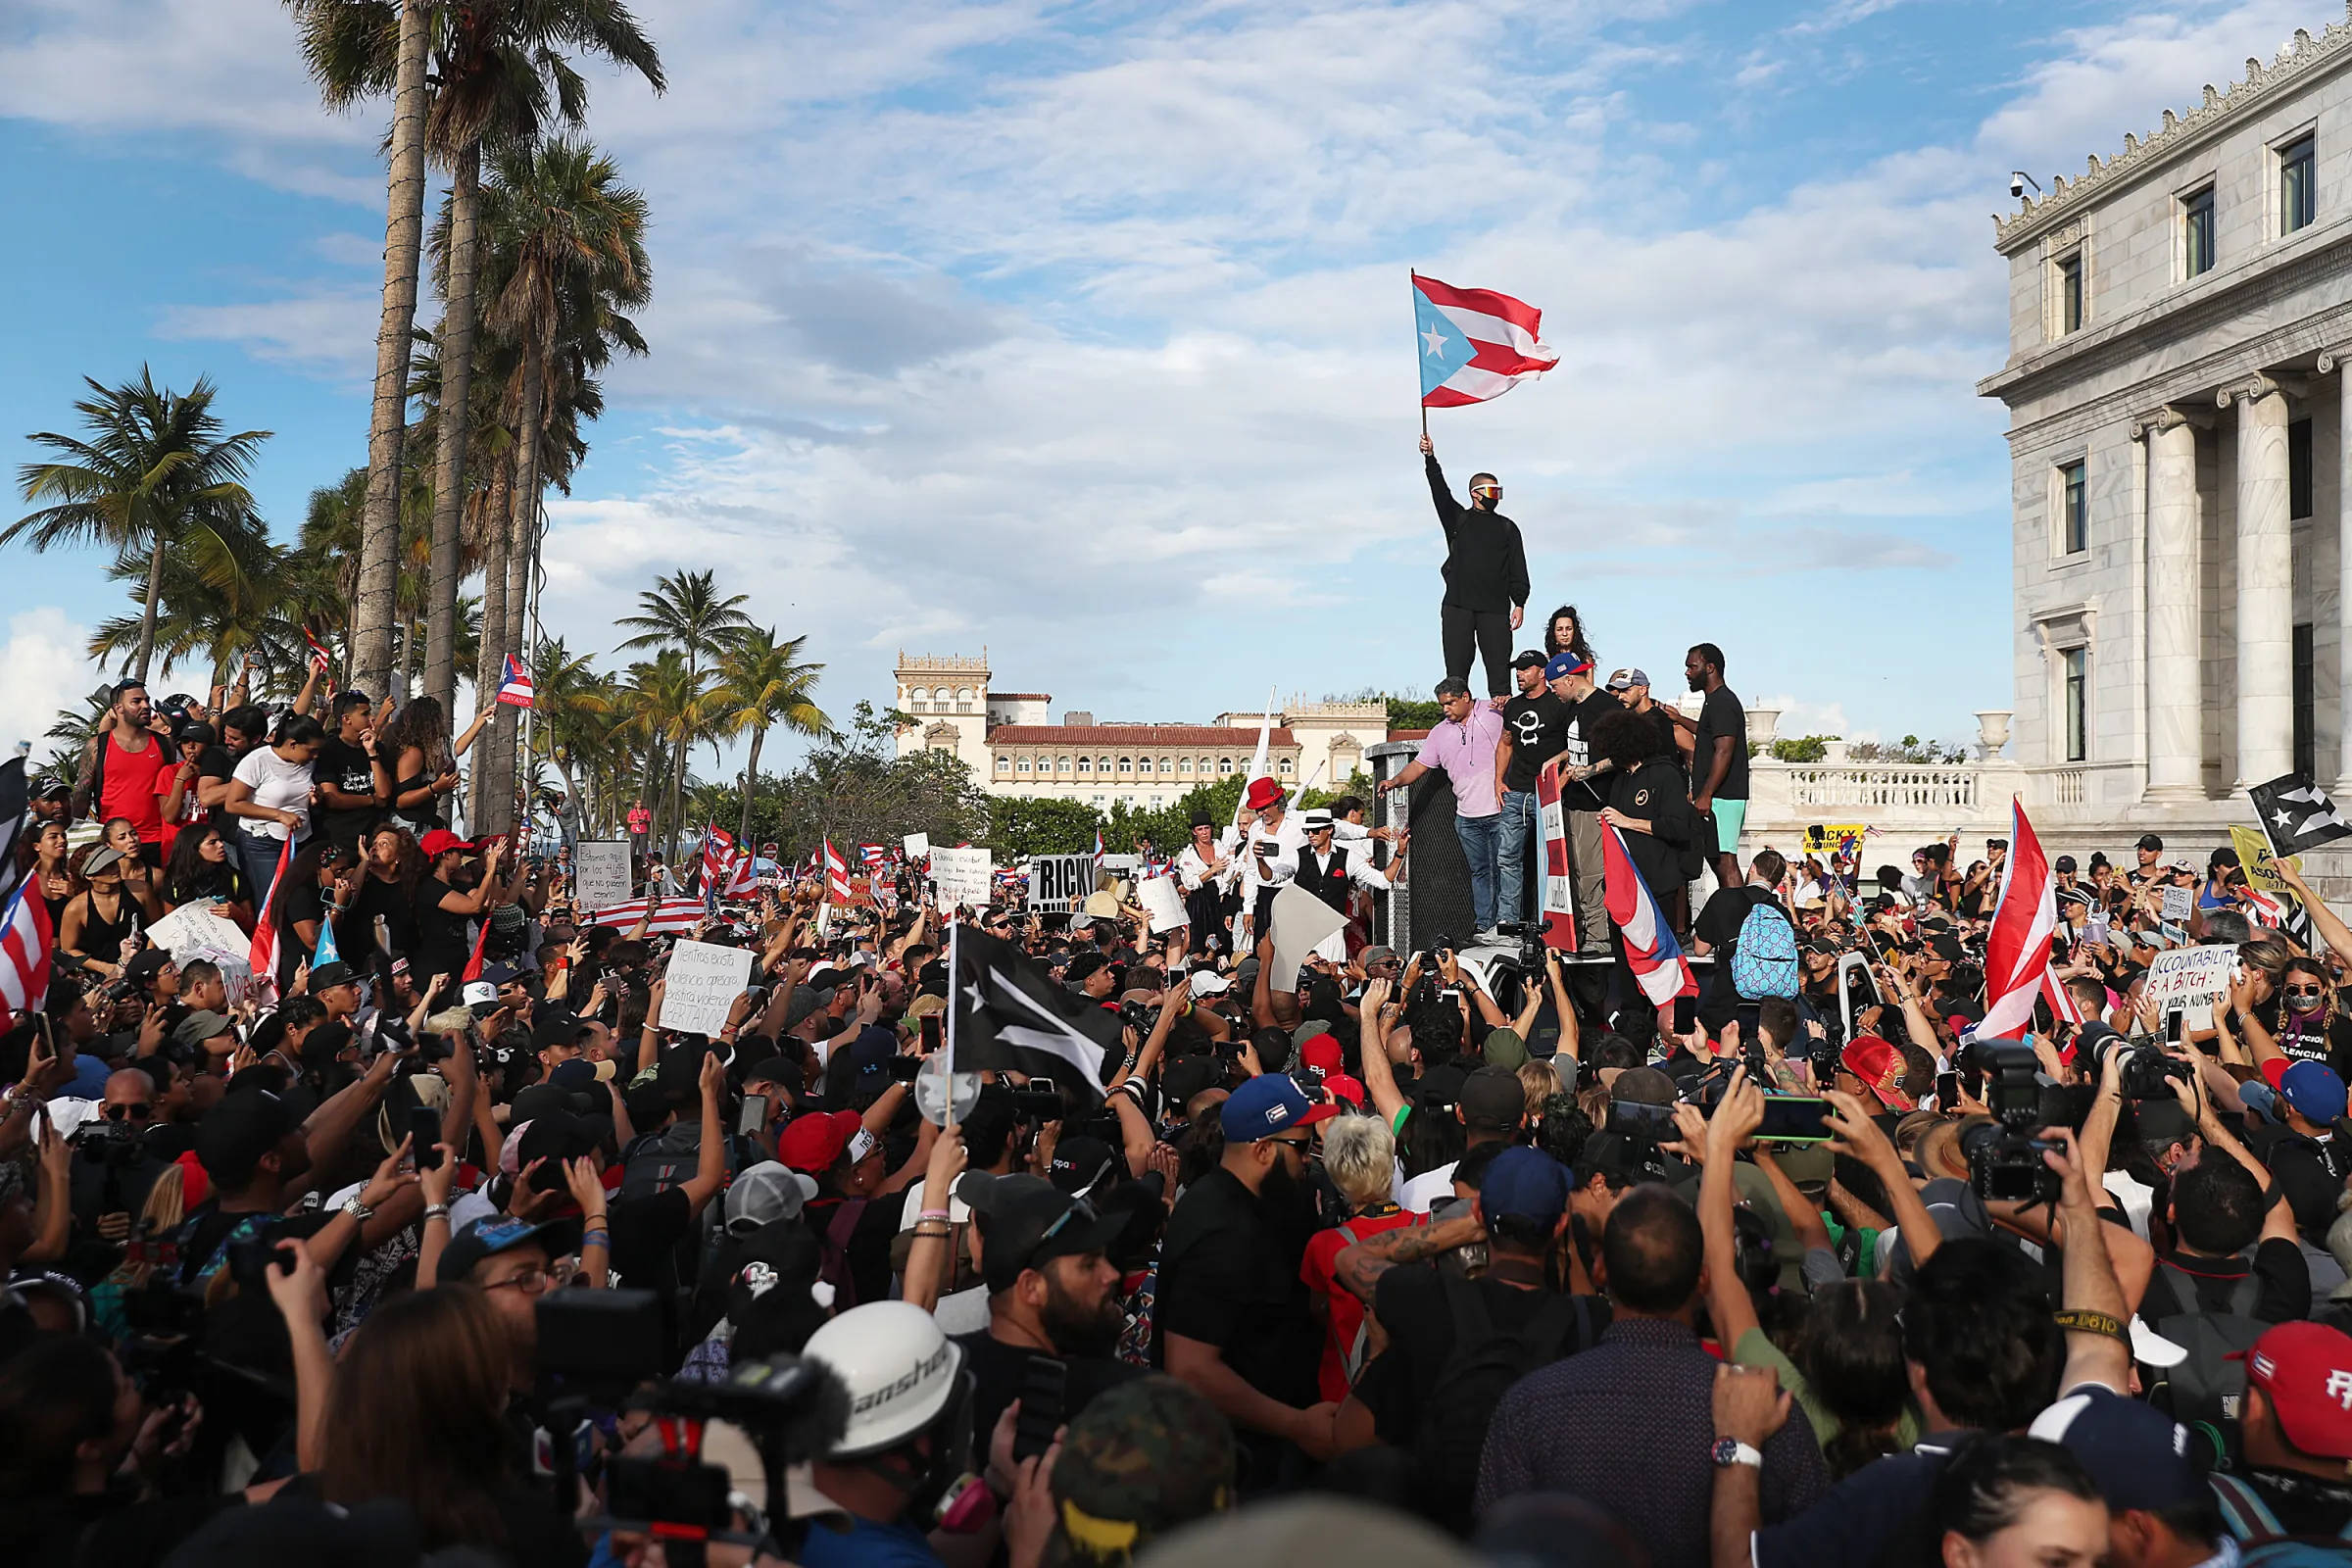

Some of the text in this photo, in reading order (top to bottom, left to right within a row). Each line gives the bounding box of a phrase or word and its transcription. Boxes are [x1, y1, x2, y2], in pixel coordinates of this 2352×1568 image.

[579, 865, 590, 876] por
[593, 864, 603, 874] los
[1032, 858, 1095, 900] #RICKY
[2151, 950, 2236, 976] ACCOUNTABILITY
[2146, 980, 2157, 996] IS
[2161, 977, 2169, 993] A
